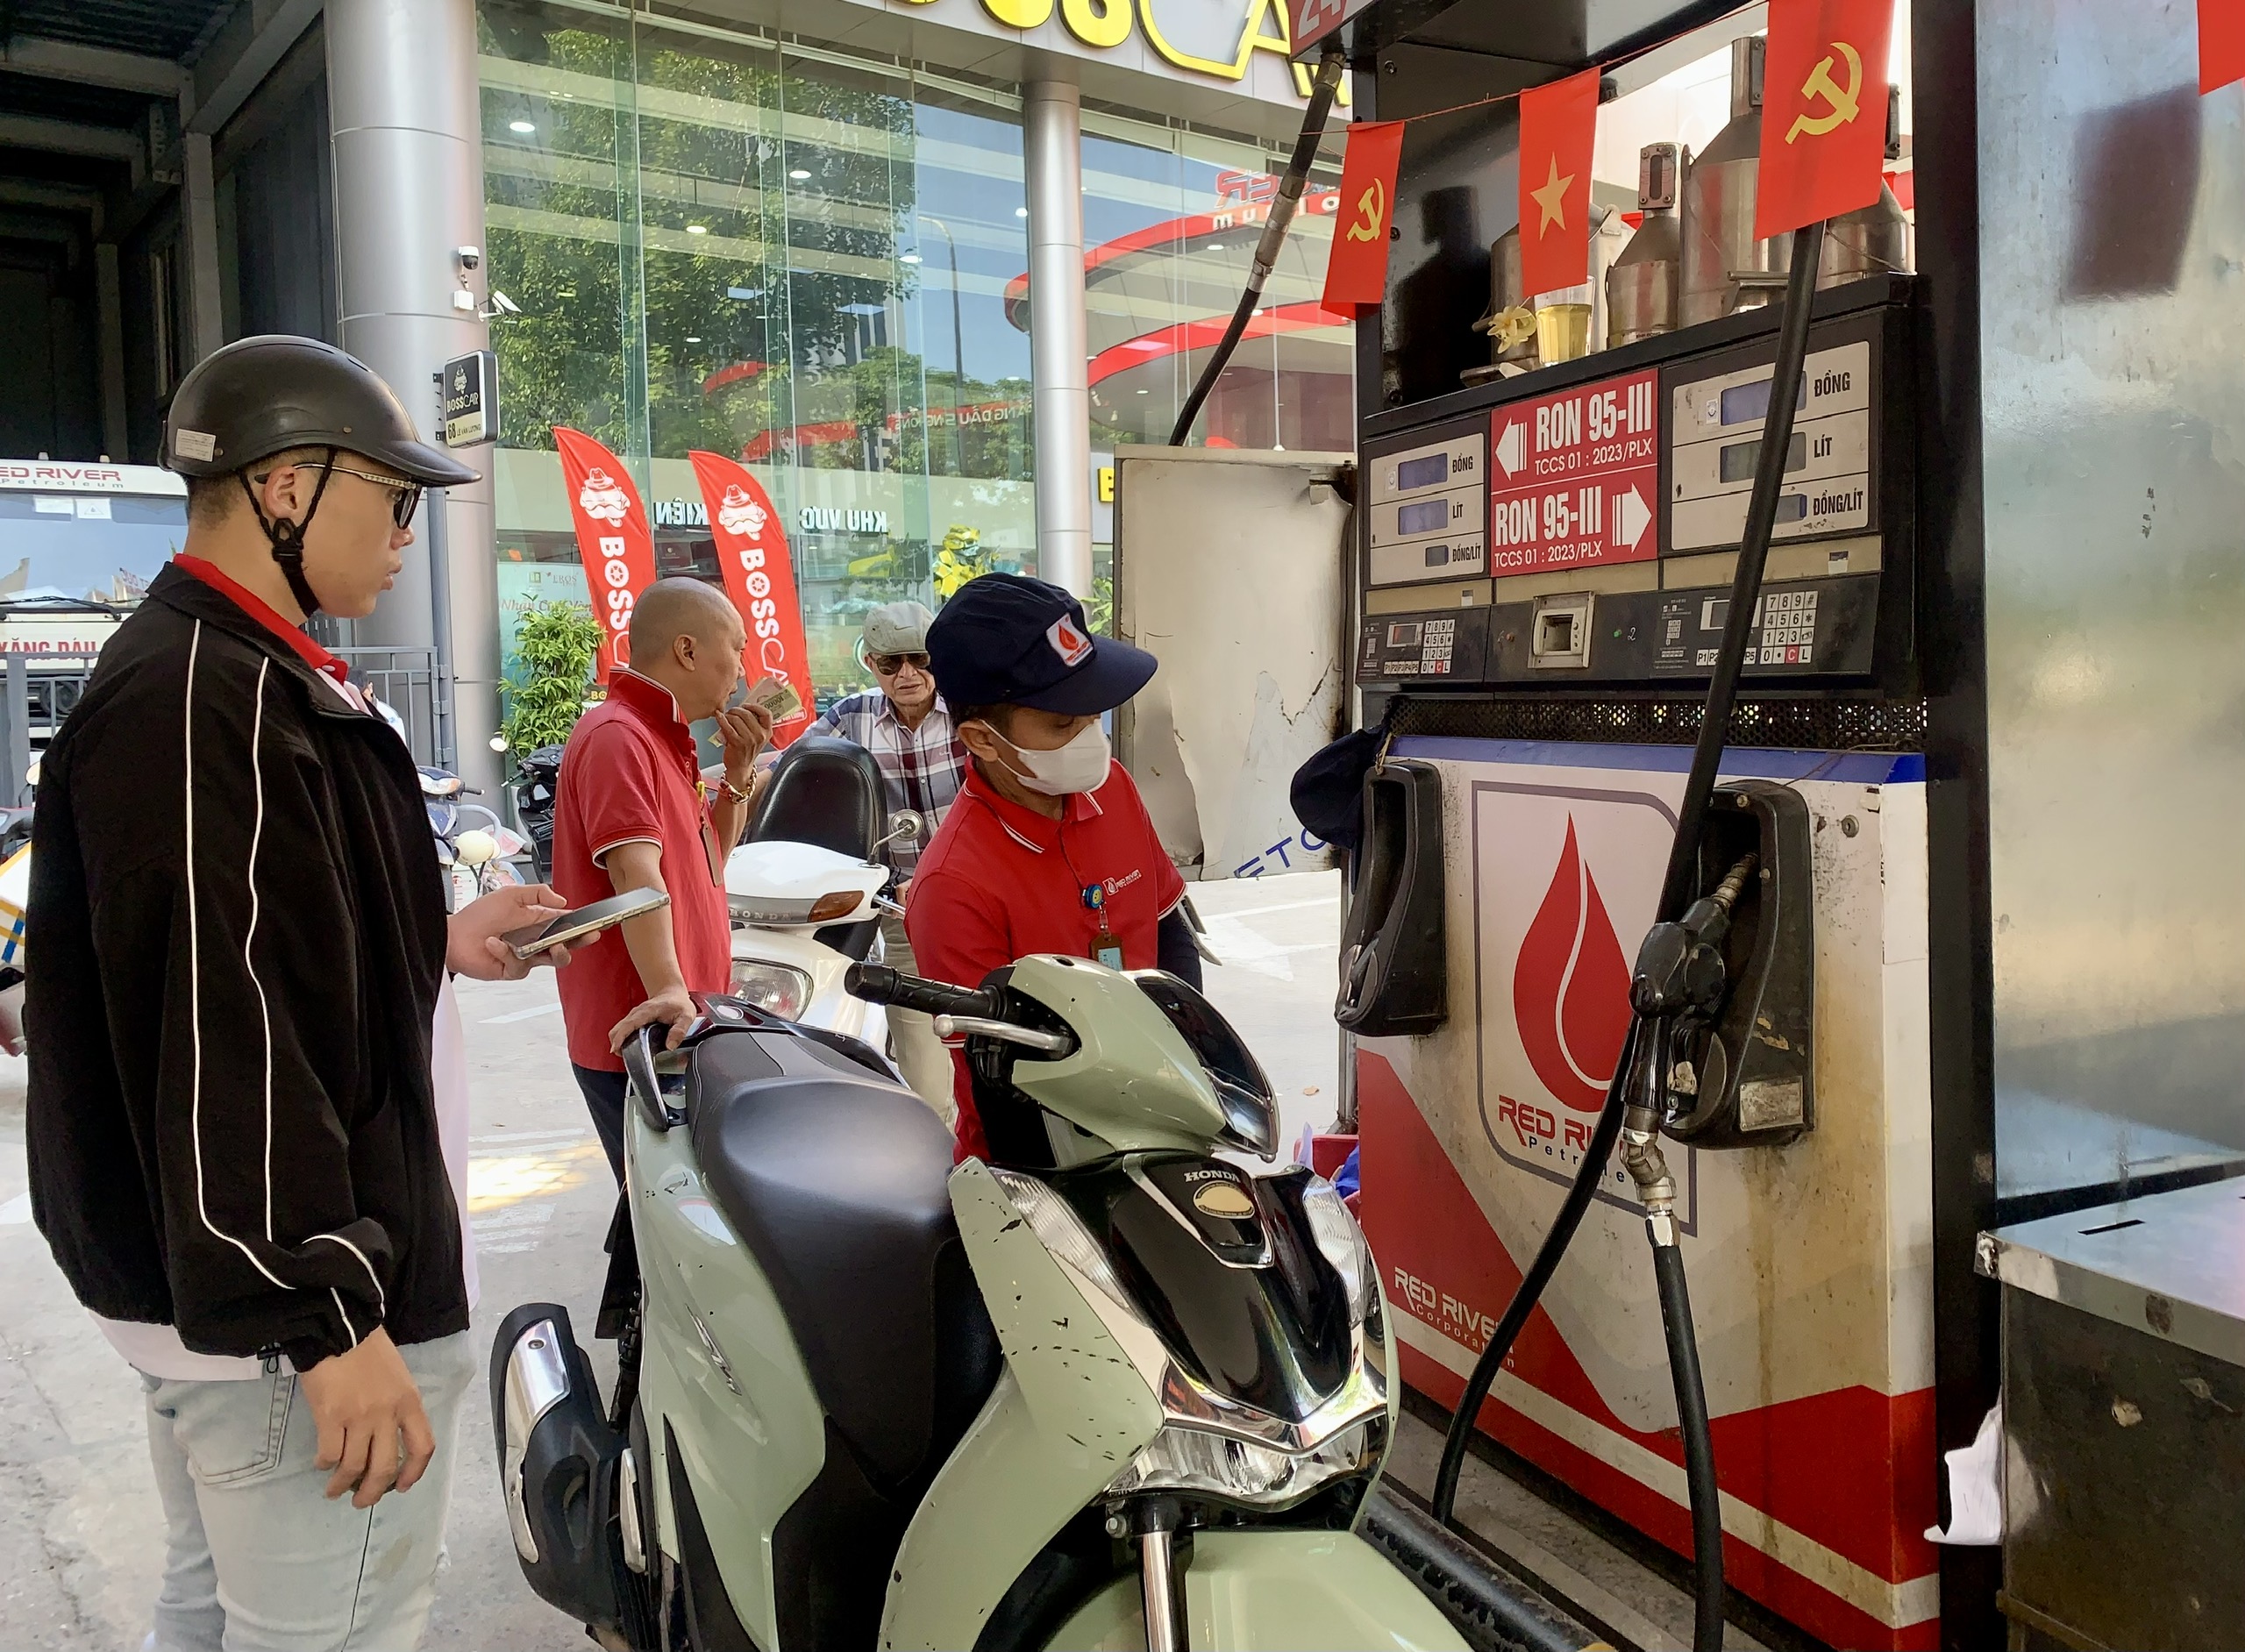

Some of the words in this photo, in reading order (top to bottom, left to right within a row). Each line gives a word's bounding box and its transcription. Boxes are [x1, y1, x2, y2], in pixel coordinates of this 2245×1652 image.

[446, 392, 479, 413] BOSSCAR
[1536, 397, 1581, 452] RON
[1588, 381, 1652, 442] 95-III
[447, 423, 456, 439] 68
[1535, 455, 1565, 474] TCCS
[1567, 451, 1581, 470] 01
[1593, 438, 1652, 466] 2023/PLX
[1814, 434, 1833, 459] LÍT
[2, 479, 124, 488] Petroleum
[36, 467, 122, 481] RIVER
[1452, 502, 1464, 519] LÍT
[1495, 497, 1537, 546] RON
[1543, 486, 1602, 541] 95-III
[1494, 550, 1522, 568] TCCS
[1525, 548, 1537, 565] 01
[1548, 540, 1603, 562] 2023/PLX
[1770, 597, 1777, 609] 7
[1782, 596, 1788, 608] 8
[1794, 595, 1801, 607] 9
[739, 548, 789, 687] BOSSCA
[1767, 615, 1774, 626] 4
[1779, 614, 1786, 625] 5
[1792, 613, 1800, 624] 6
[1778, 631, 1785, 643] 2
[1790, 630, 1797, 642] 3
[1788, 649, 1796, 660] C
[1802, 649, 1808, 659] L
[1499, 1094, 1556, 1147] RED
[1184, 1170, 1241, 1183] HONDA
[1394, 1266, 1436, 1312] RED
[1442, 1292, 1514, 1354] RIVE
